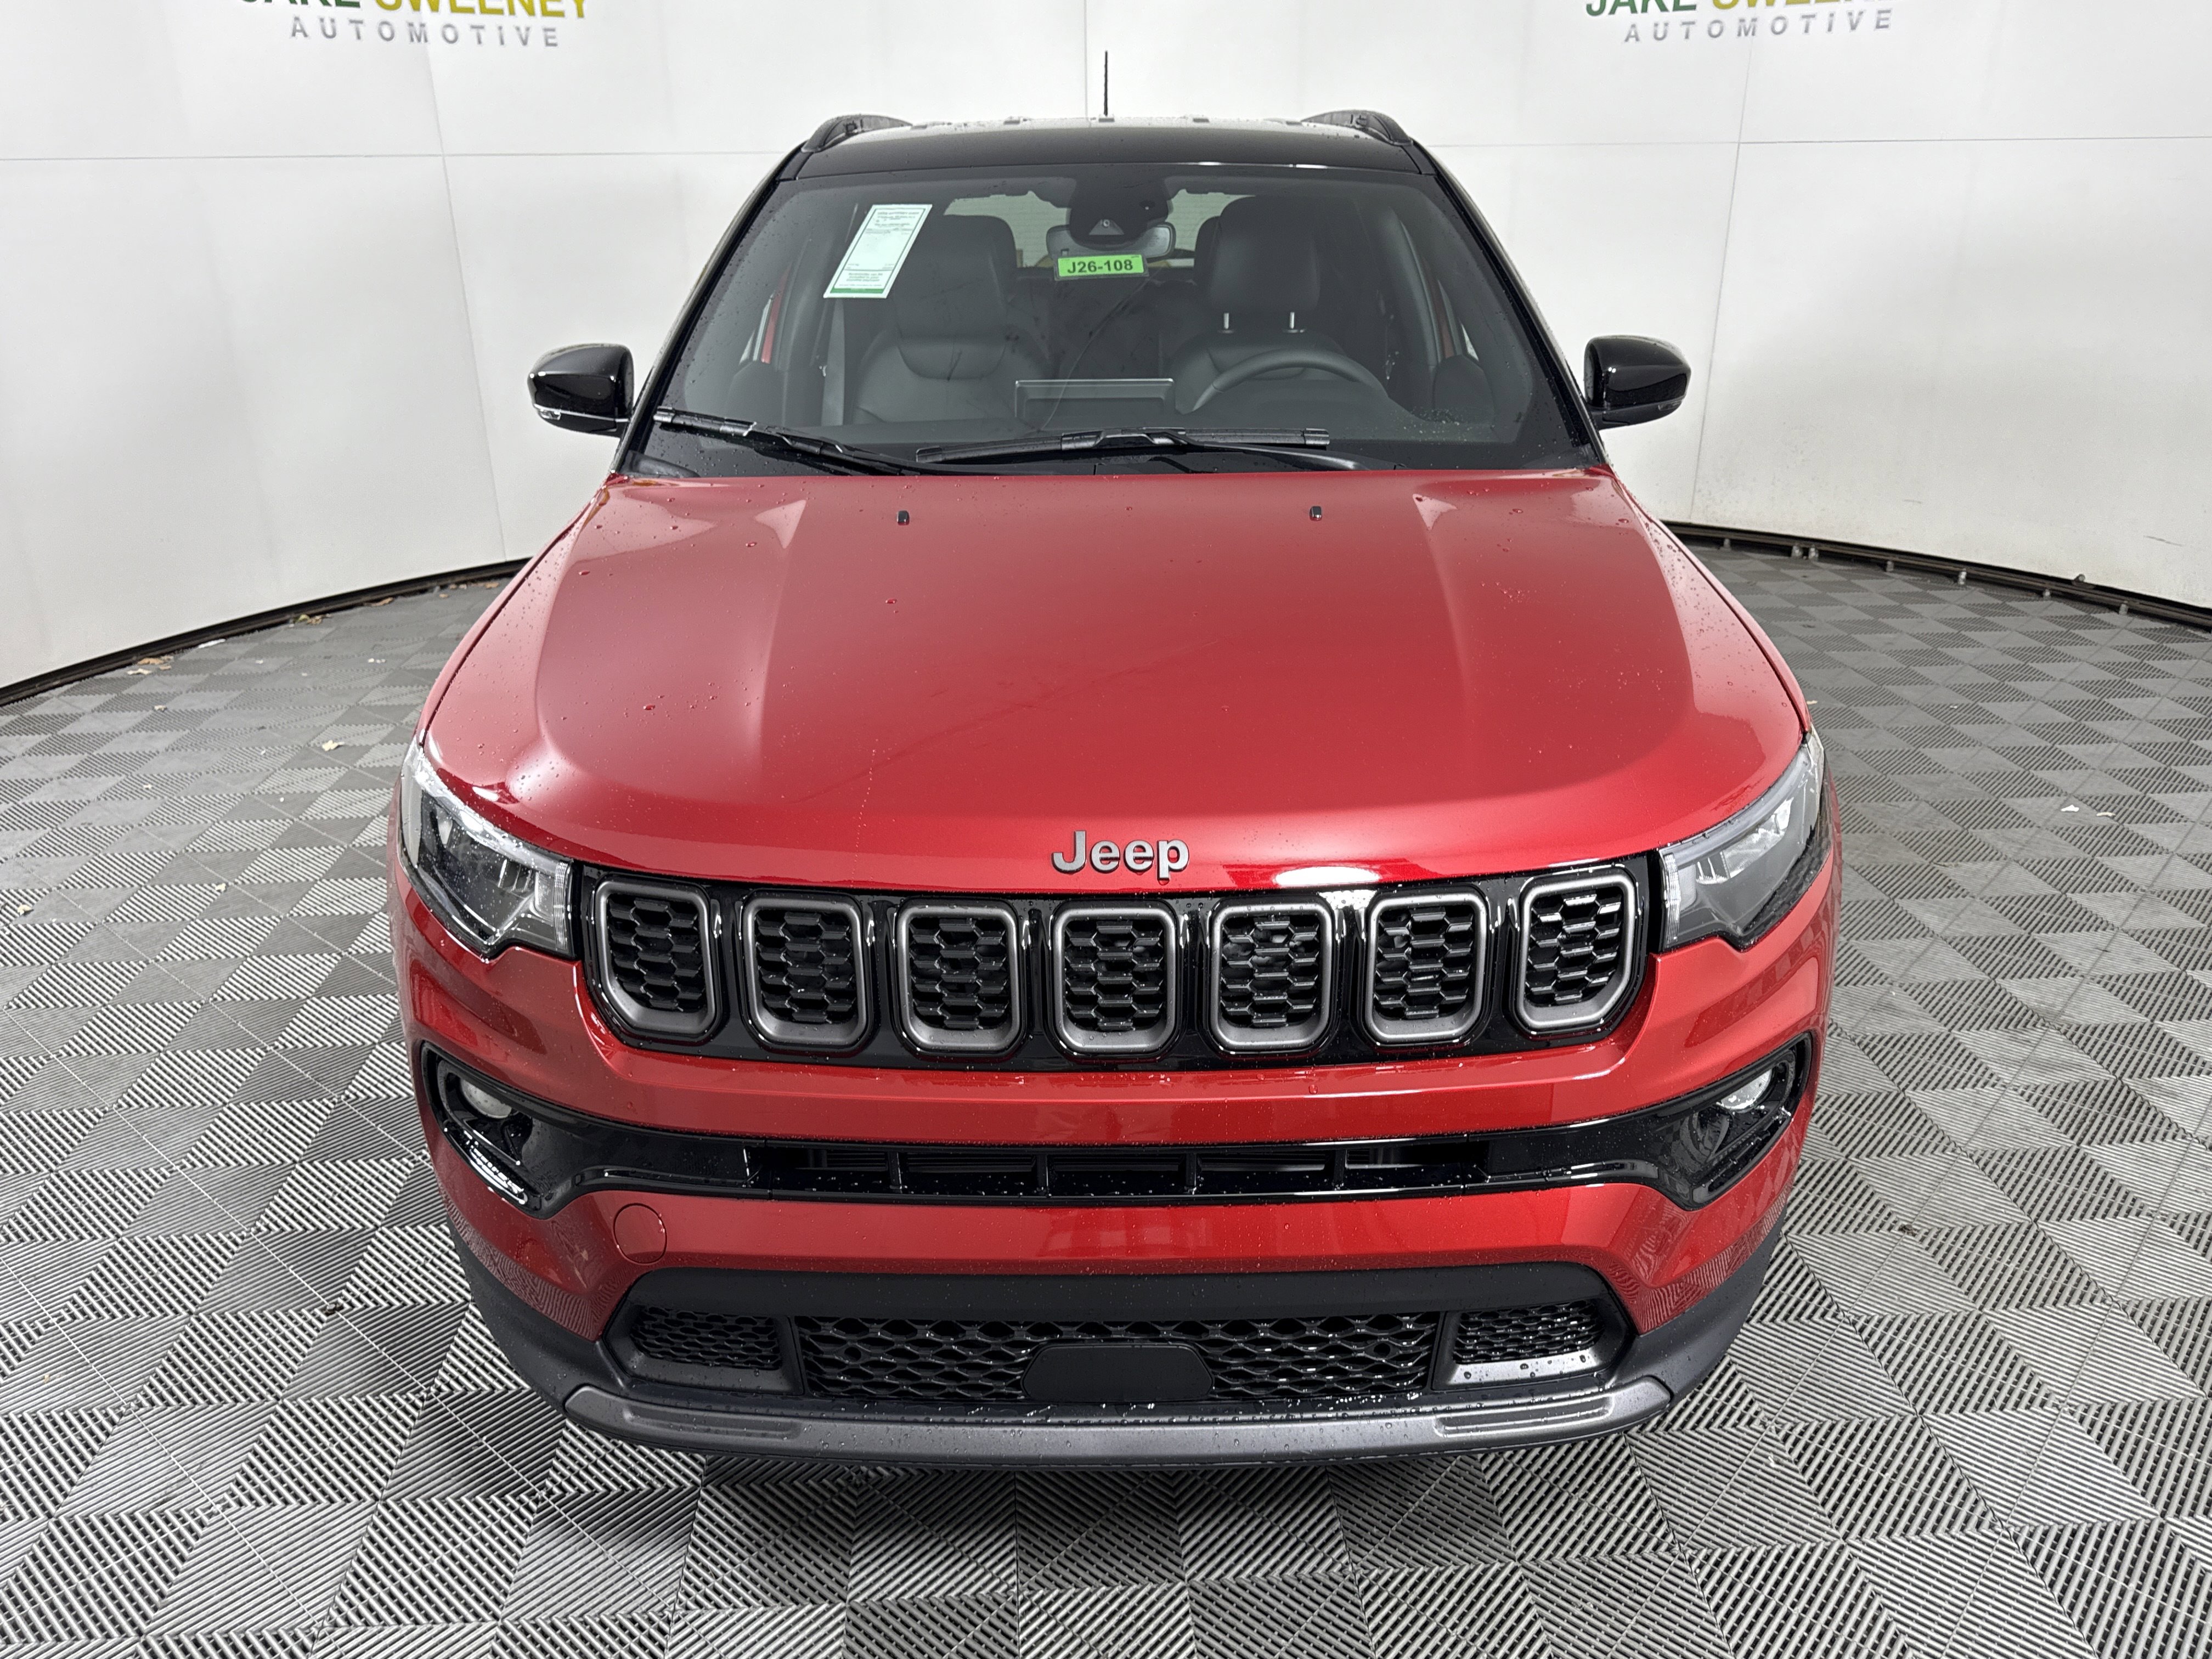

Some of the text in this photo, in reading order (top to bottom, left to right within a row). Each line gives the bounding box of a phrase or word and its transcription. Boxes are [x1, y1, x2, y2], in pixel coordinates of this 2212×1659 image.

[291, 15, 558, 48] AUTOMOTIVE
[1624, 9, 1892, 43] AUTOMOTIVE
[1067, 258, 1133, 274] J26-108
[1052, 830, 1189, 880] Jeep
